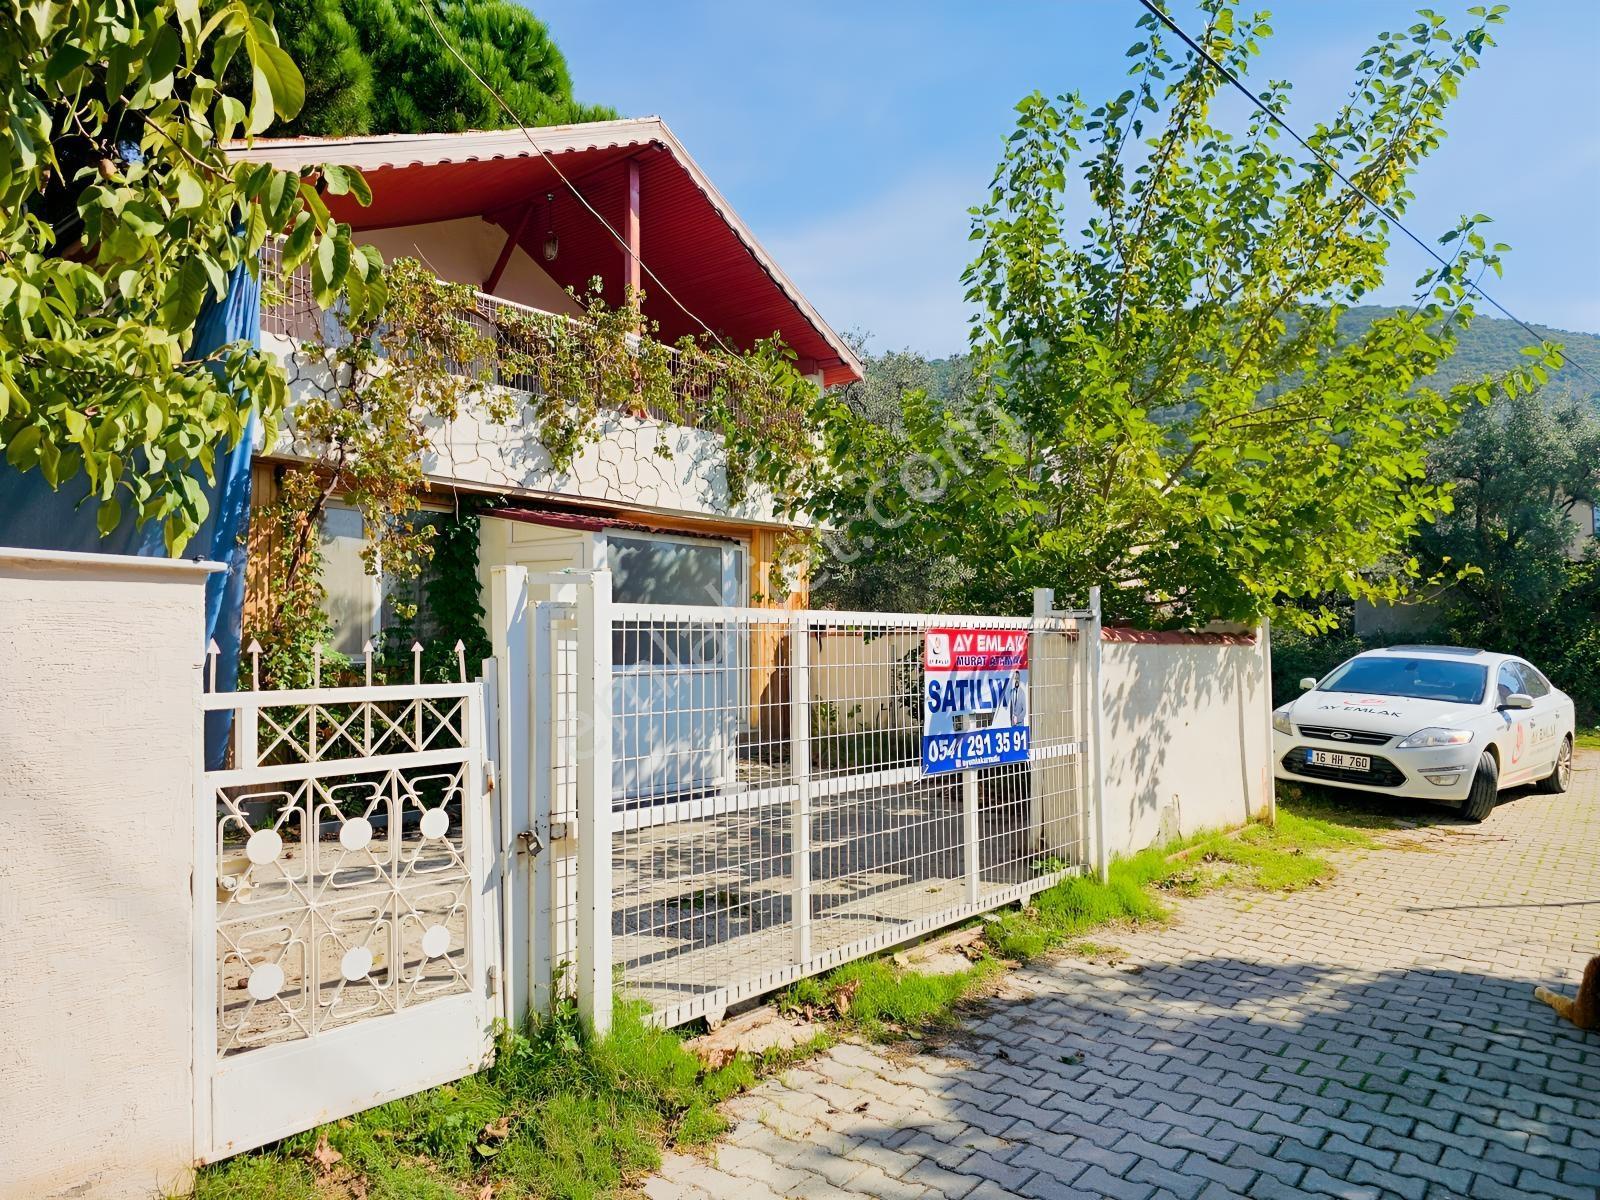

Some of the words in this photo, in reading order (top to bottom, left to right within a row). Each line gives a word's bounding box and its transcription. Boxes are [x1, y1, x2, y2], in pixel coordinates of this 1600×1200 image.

[953, 633, 973, 652] AY
[977, 634, 1024, 652] EMLAK
[956, 655, 987, 666] MURAT
[928, 678, 1010, 713] SATILIK
[1344, 706, 1402, 717] EMLAK
[967, 734, 991, 756] 291
[996, 732, 1010, 753] 35
[1013, 730, 1026, 751] 91
[1316, 752, 1326, 763] 16
[1332, 754, 1343, 765] HH
[1349, 756, 1368, 768] 760
